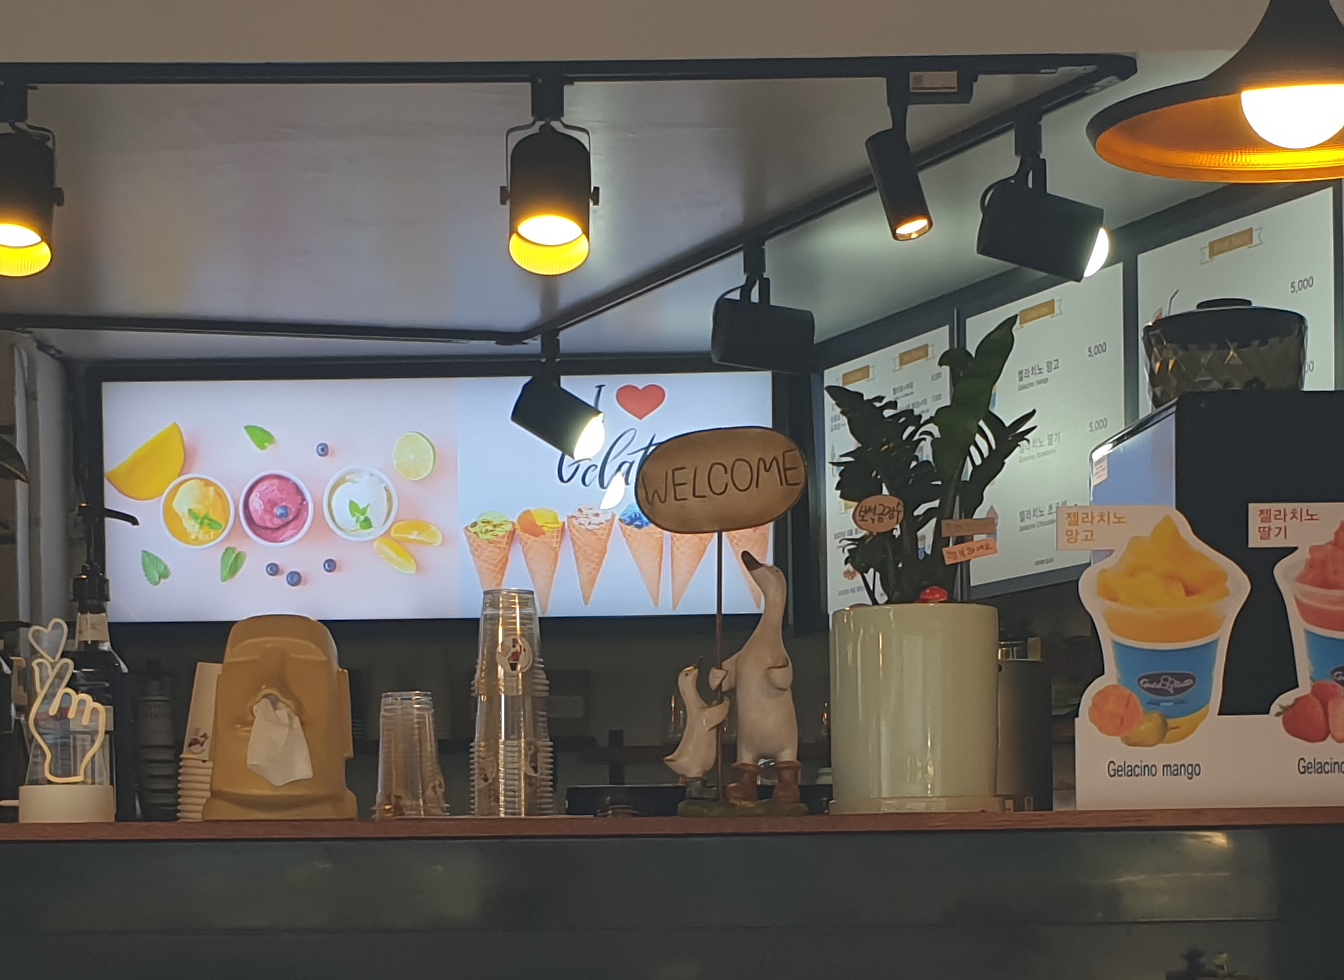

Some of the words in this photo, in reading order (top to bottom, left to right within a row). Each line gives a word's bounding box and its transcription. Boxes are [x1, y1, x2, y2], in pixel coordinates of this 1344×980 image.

[1290, 276, 1314, 294] 5,000
[1087, 342, 1107, 358] 5,000
[1089, 417, 1108, 433] 5,000
[640, 447, 804, 506] WELCOME
[1065, 511, 1127, 526] 젤라치노
[1258, 508, 1319, 523] 젤라치노
[1065, 528, 1096, 544] 망고
[1258, 525, 1287, 540] 딸기
[1107, 760, 1157, 778] Gelacino
[1162, 762, 1202, 781] mango
